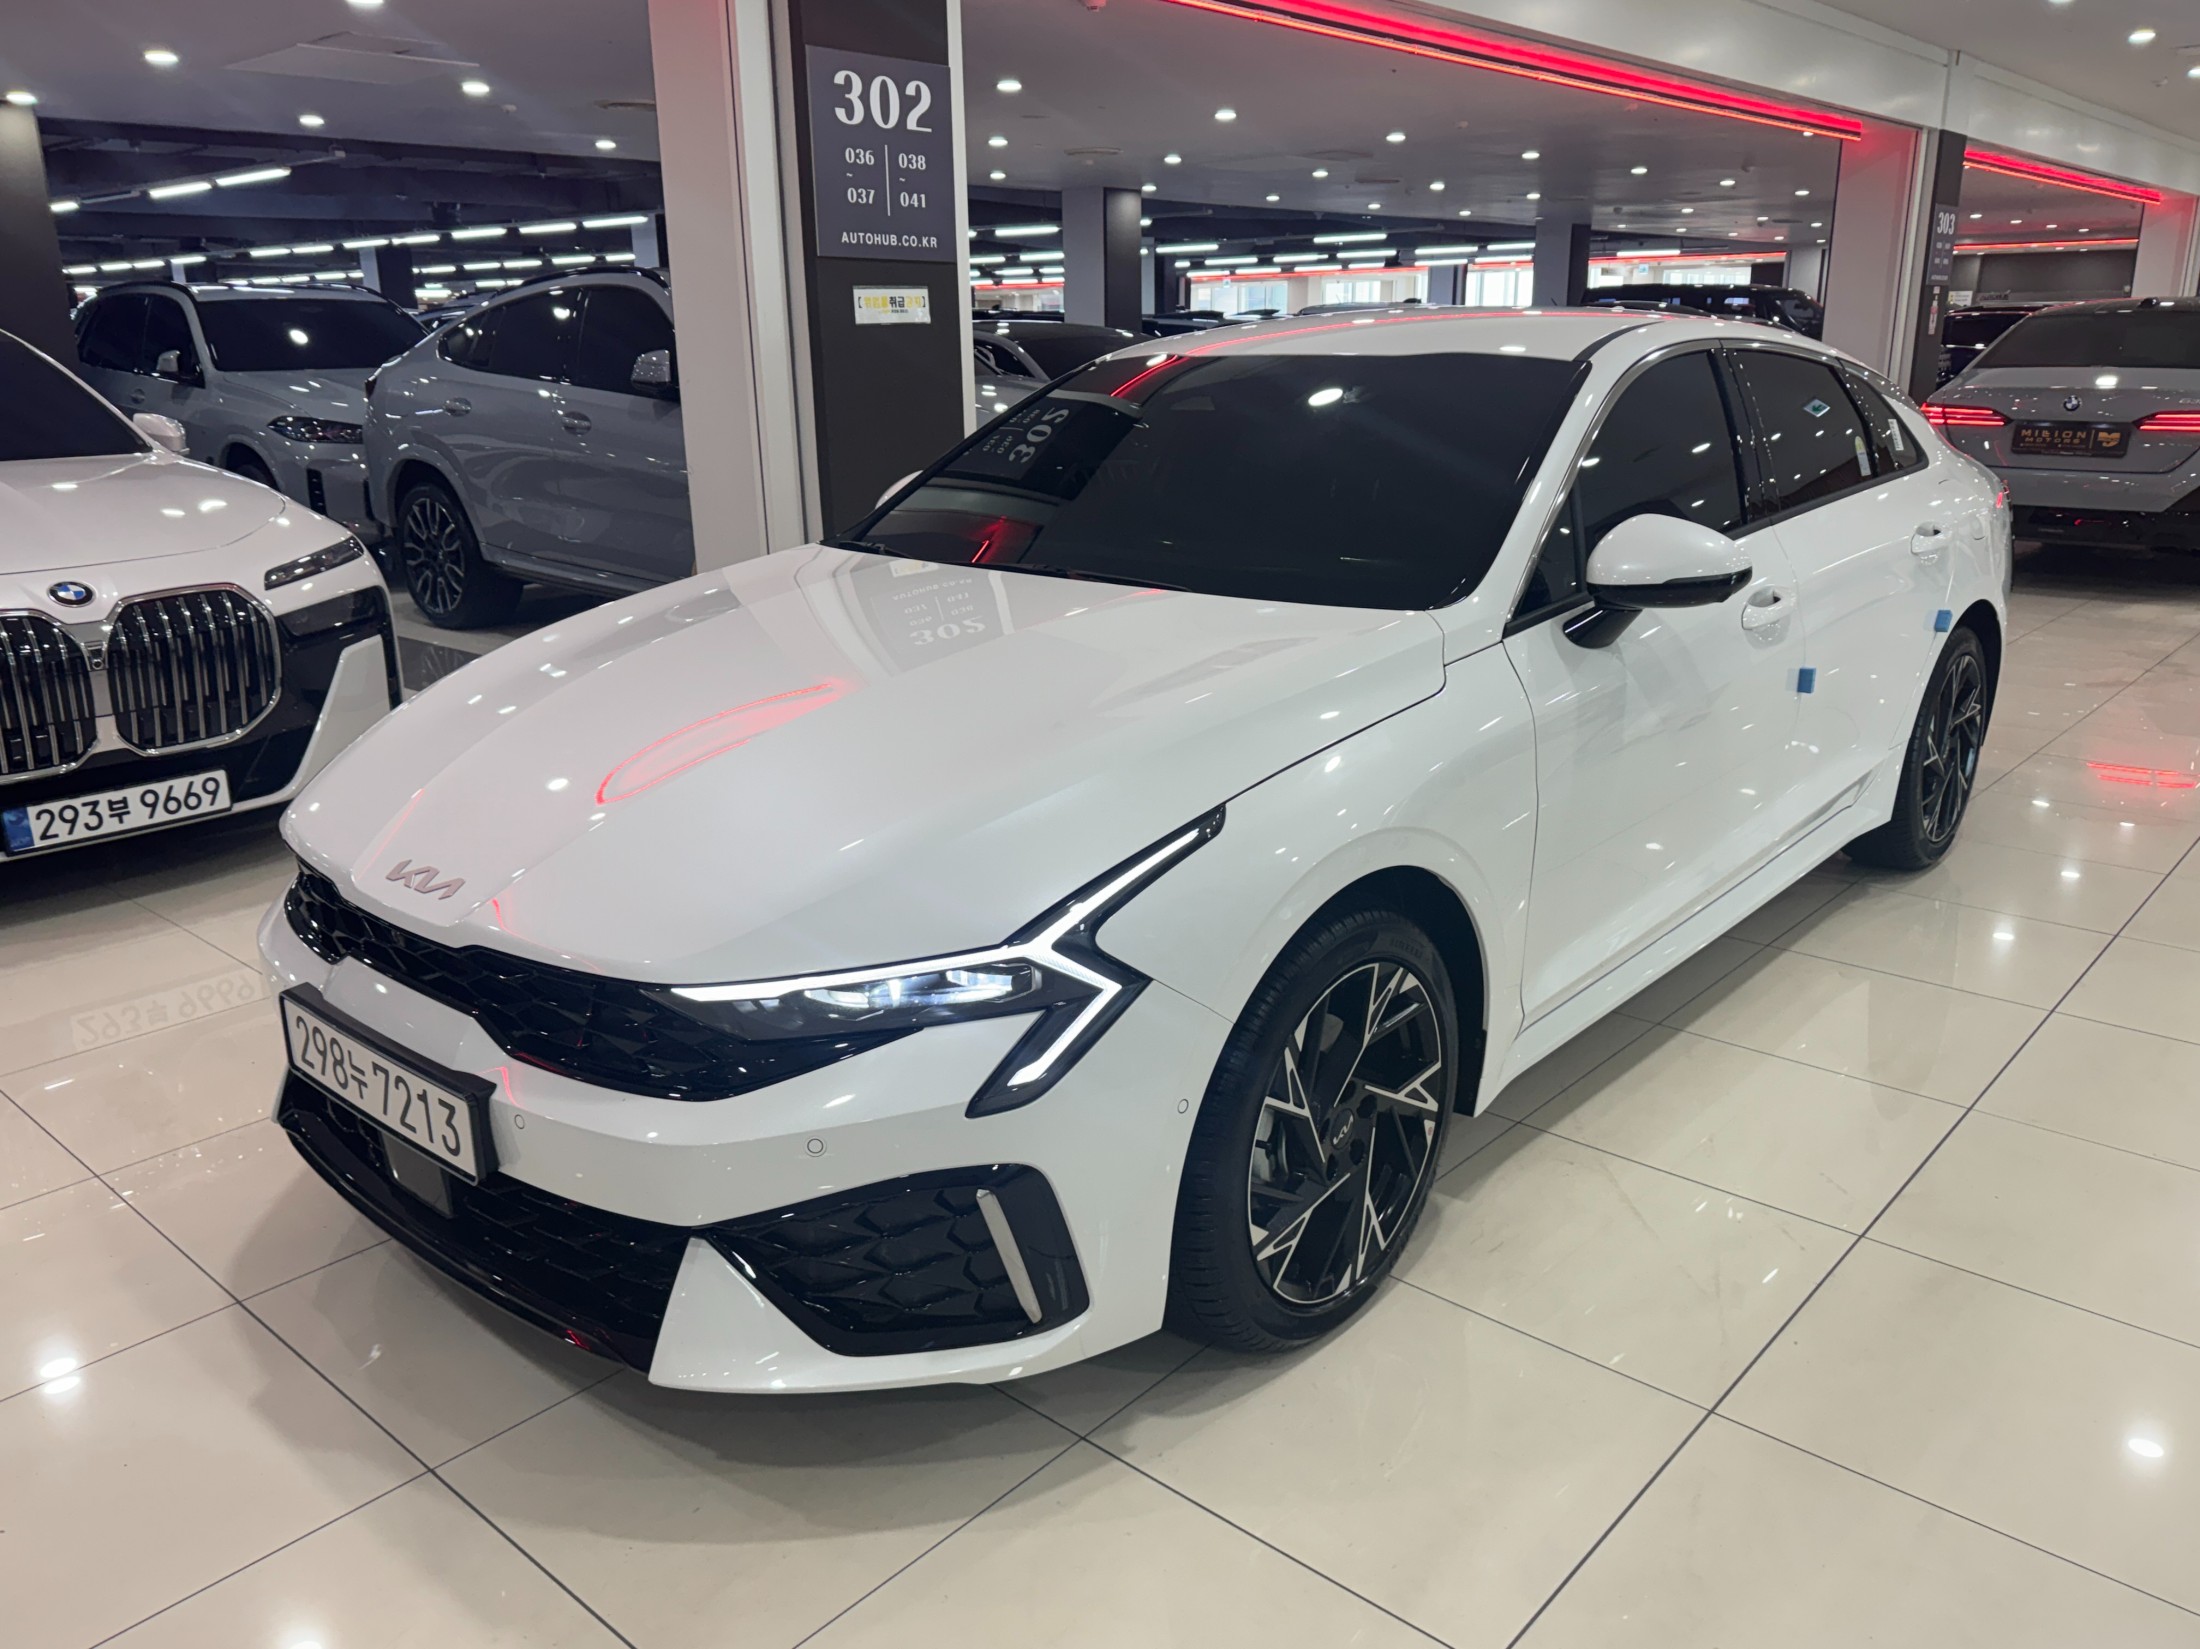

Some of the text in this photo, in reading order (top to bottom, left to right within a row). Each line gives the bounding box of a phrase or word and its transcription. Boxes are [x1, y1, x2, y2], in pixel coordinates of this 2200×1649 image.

[833, 70, 932, 132] 302
[845, 147, 875, 165] 036
[898, 153, 926, 170] 038
[847, 187, 875, 204] 037
[900, 192, 926, 208] 041
[1937, 212, 1956, 235] 303
[841, 231, 937, 248] AUTOHUB.CO.KR
[35, 777, 220, 841] 293부 9669
